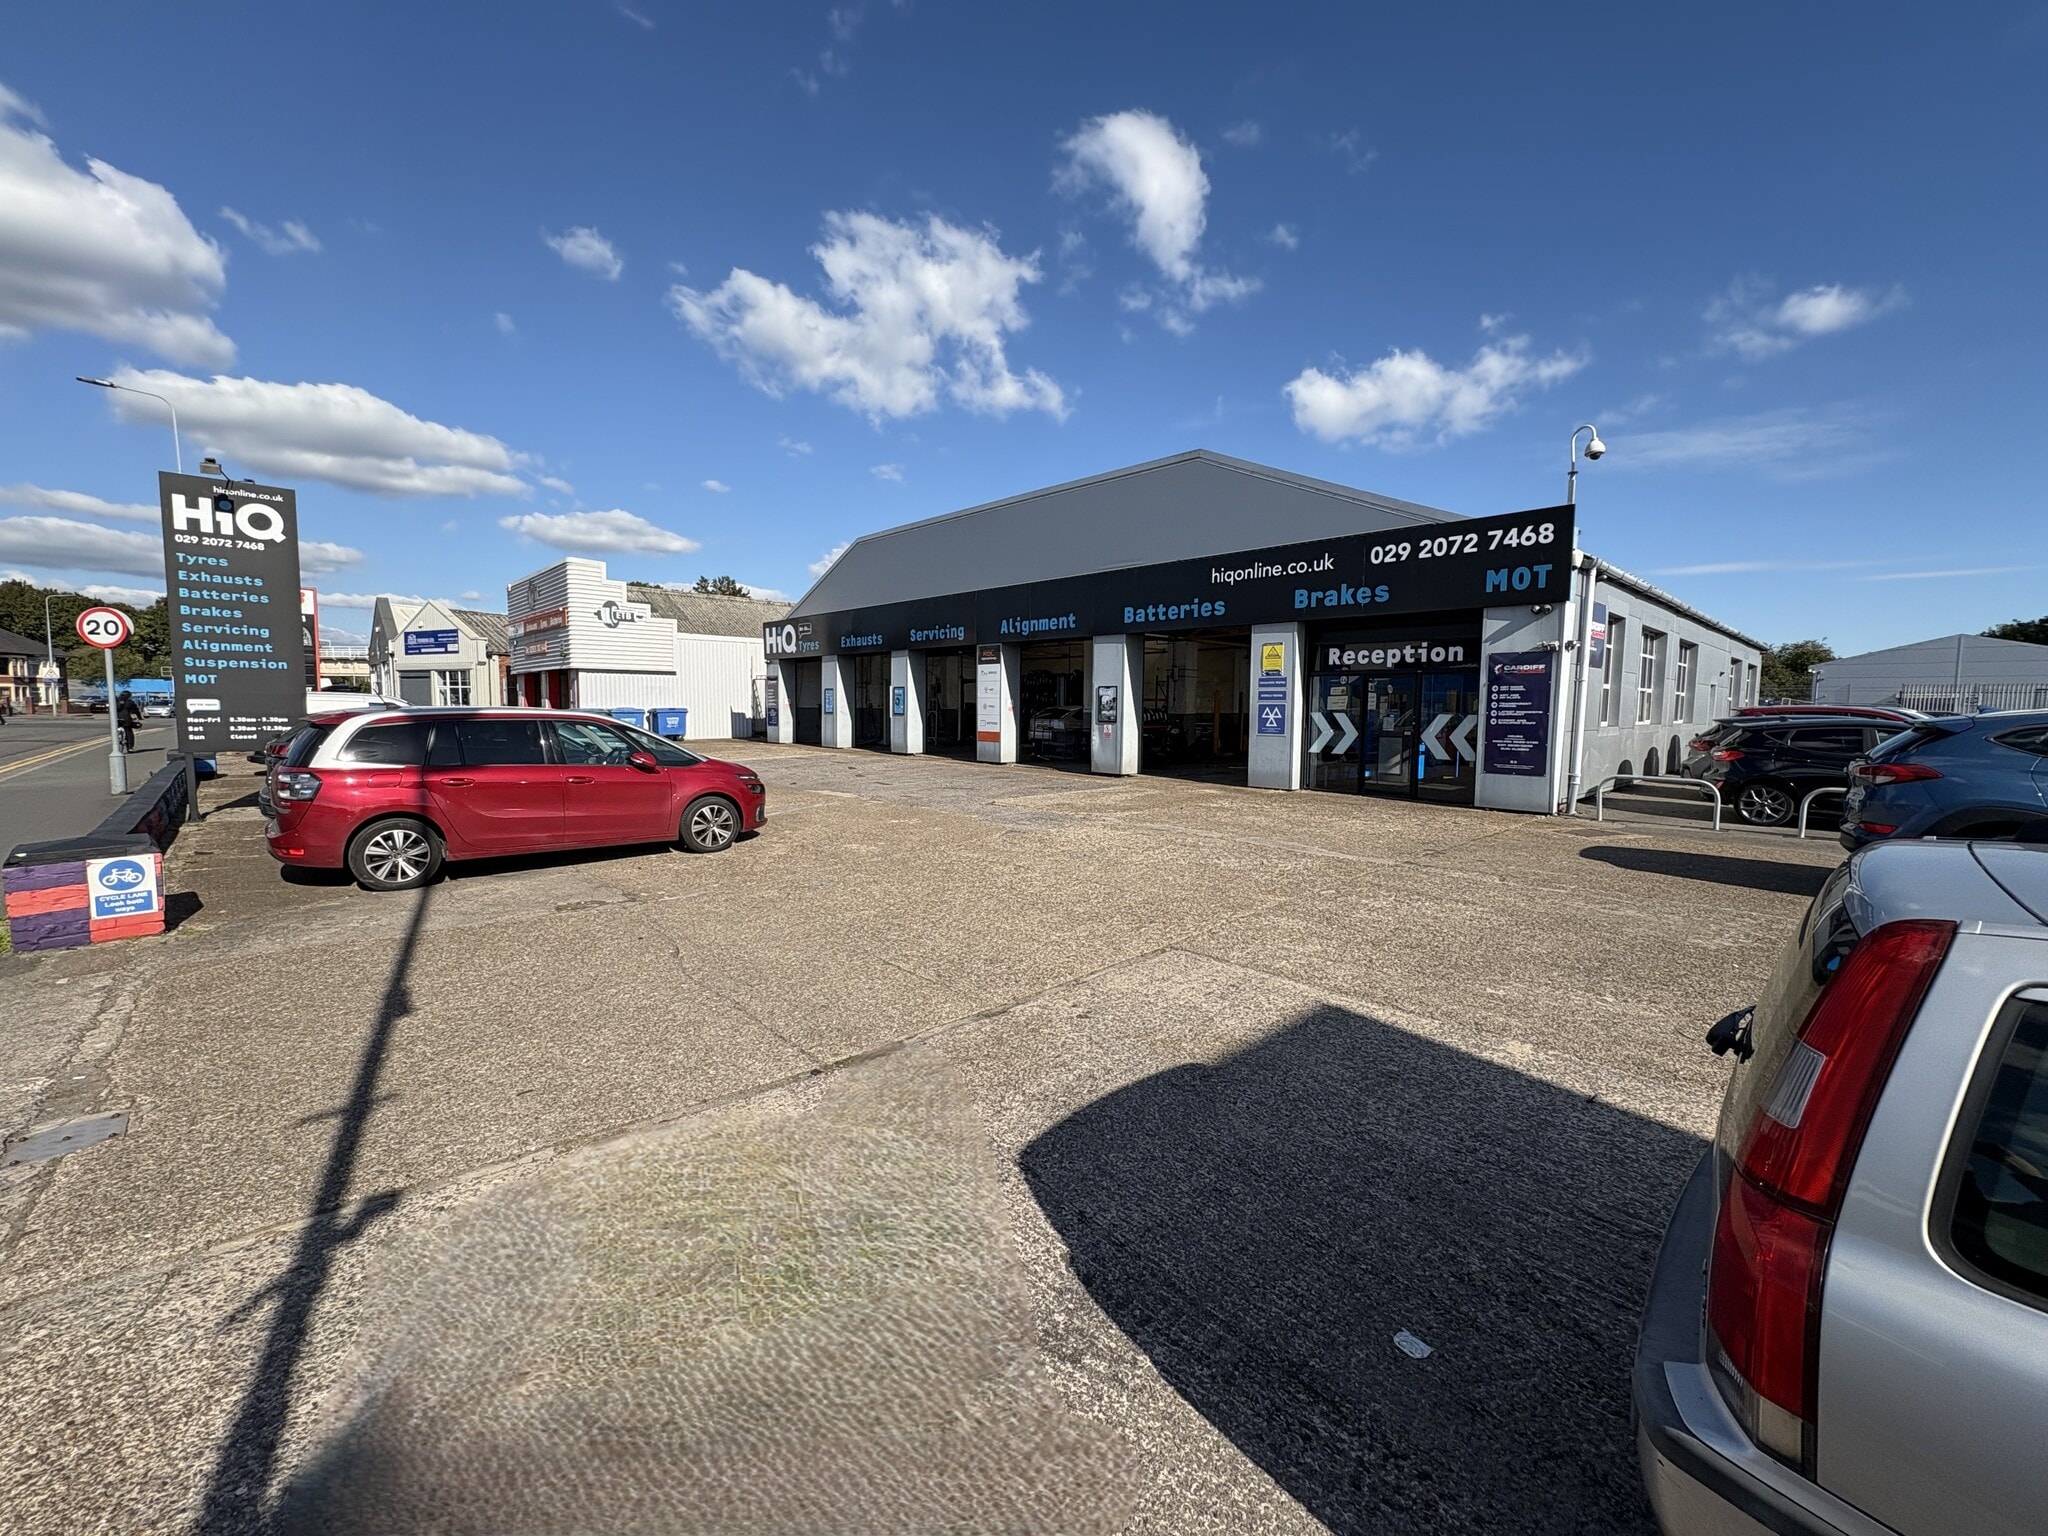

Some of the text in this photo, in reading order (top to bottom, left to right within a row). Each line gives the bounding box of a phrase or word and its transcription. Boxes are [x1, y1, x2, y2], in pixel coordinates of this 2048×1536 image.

[213, 486, 284, 502] hiqonline.co.uk
[171, 493, 287, 544] HiQ
[174, 534, 265, 551] 029 2072 7468
[1370, 522, 1555, 565] 029 2072 7468
[175, 552, 229, 567] Tyres
[1211, 552, 1335, 586] hiqonline.co.uk
[178, 570, 263, 586] Exhausts
[1485, 564, 1553, 593] MOT
[178, 587, 270, 604] Batteries
[1294, 583, 1390, 609] Brakes
[180, 605, 243, 618] Brakes
[615, 611, 632, 620] ETB
[1123, 598, 1226, 624] Batteries
[86, 619, 119, 636] 20
[181, 622, 270, 638] Servicing
[1000, 612, 1076, 636] Alignment
[765, 624, 797, 654] HiQ
[840, 633, 883, 648] Exhausts
[909, 624, 965, 642] Servicing
[182, 639, 273, 653] Alignment
[798, 640, 820, 653] Tyres
[184, 656, 288, 670] Suspension
[1328, 642, 1464, 668] Reception
[184, 674, 217, 684] MOT
[99, 891, 148, 902] CYCLE LANE
[104, 900, 125, 908] Look
